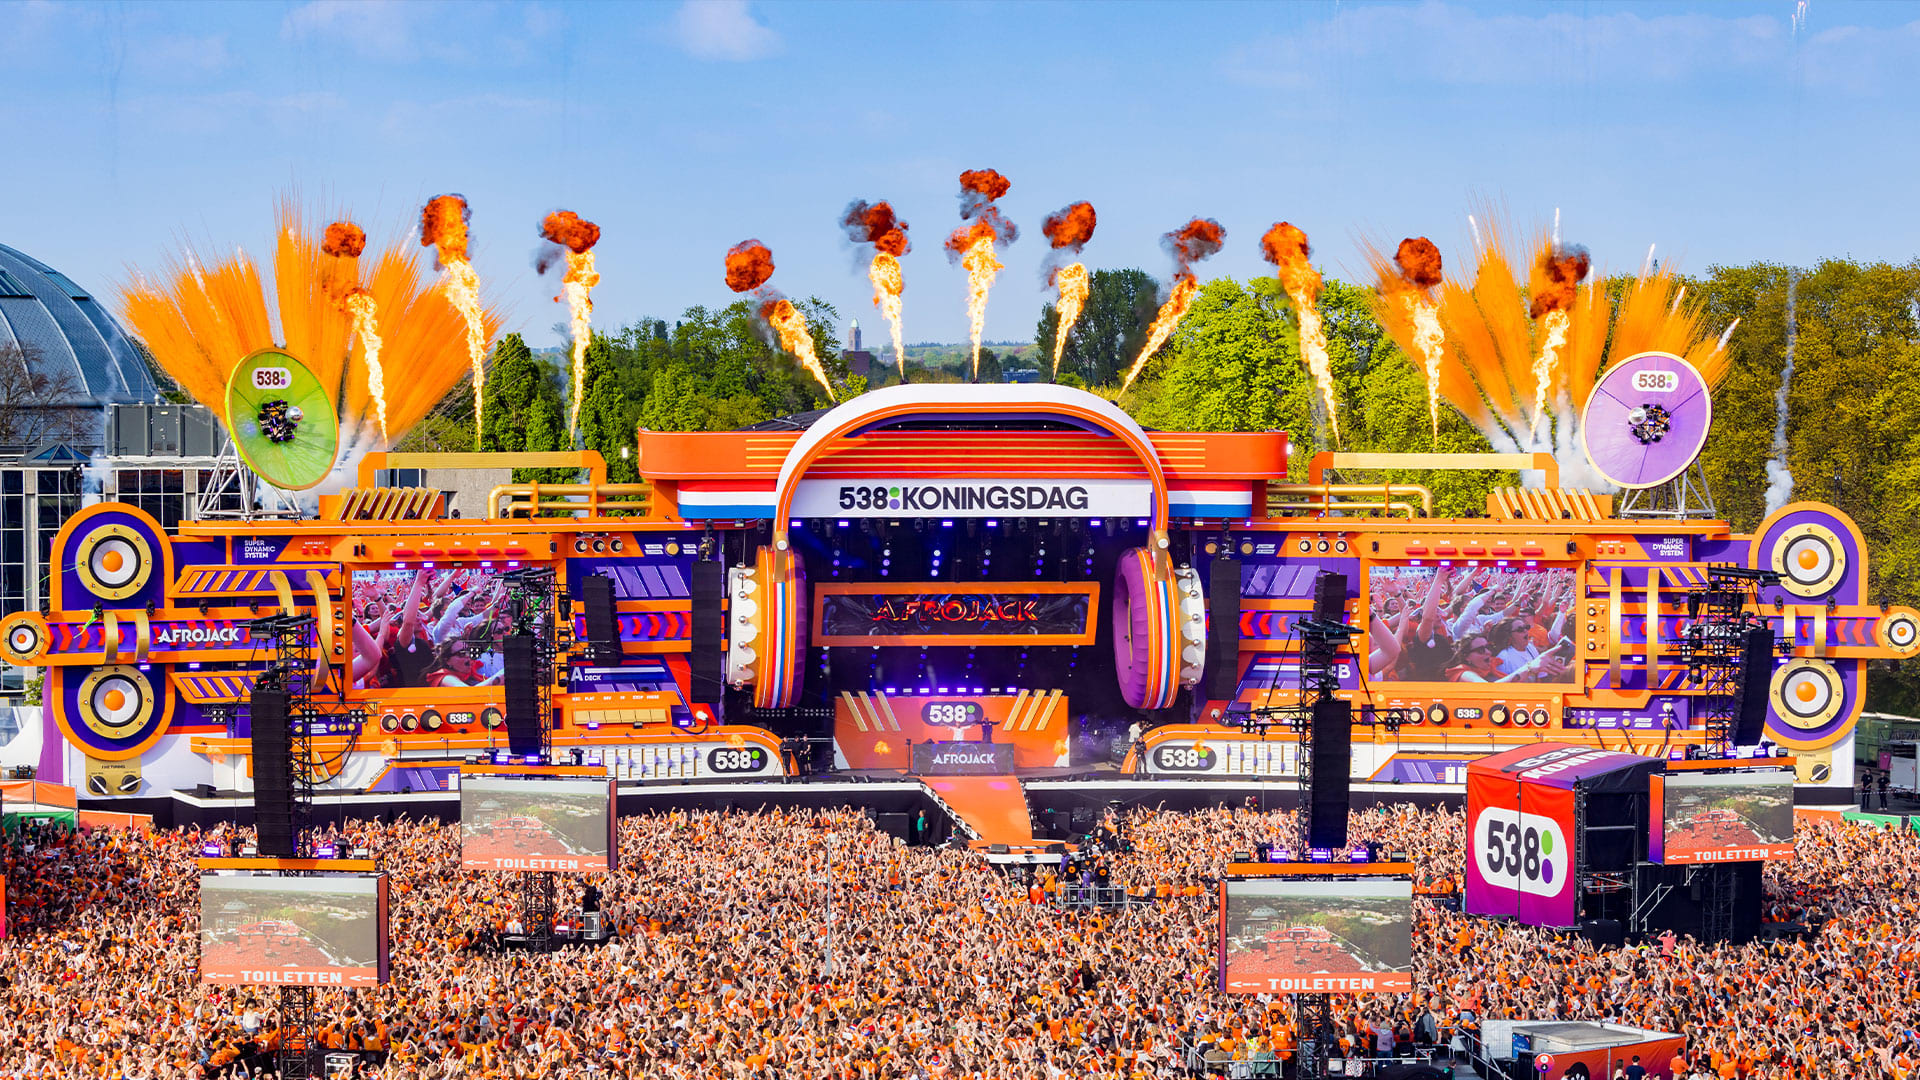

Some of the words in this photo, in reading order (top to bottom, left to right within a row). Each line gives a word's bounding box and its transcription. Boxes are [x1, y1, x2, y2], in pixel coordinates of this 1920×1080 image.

[257, 371, 280, 386] 538
[1638, 374, 1666, 388] 538
[839, 486, 888, 510] 538
[902, 486, 1089, 510] KONINGSDAG
[870, 600, 1038, 621] AFROJACK
[157, 628, 239, 642] AFROJACK
[571, 667, 583, 681] A
[1338, 664, 1350, 679] B
[450, 714, 468, 723] 538
[929, 705, 966, 723] 538
[1457, 709, 1476, 718] 538
[715, 751, 752, 769] 538
[932, 754, 995, 765] AFROJACK
[1160, 749, 1199, 767] 538
[1487, 819, 1540, 881] 538
[1694, 848, 1769, 861] TOILETTEN
[493, 858, 578, 870] TOILETTEN
[240, 970, 342, 984] TOILETTEN
[1267, 977, 1374, 990] TOILETTEN
